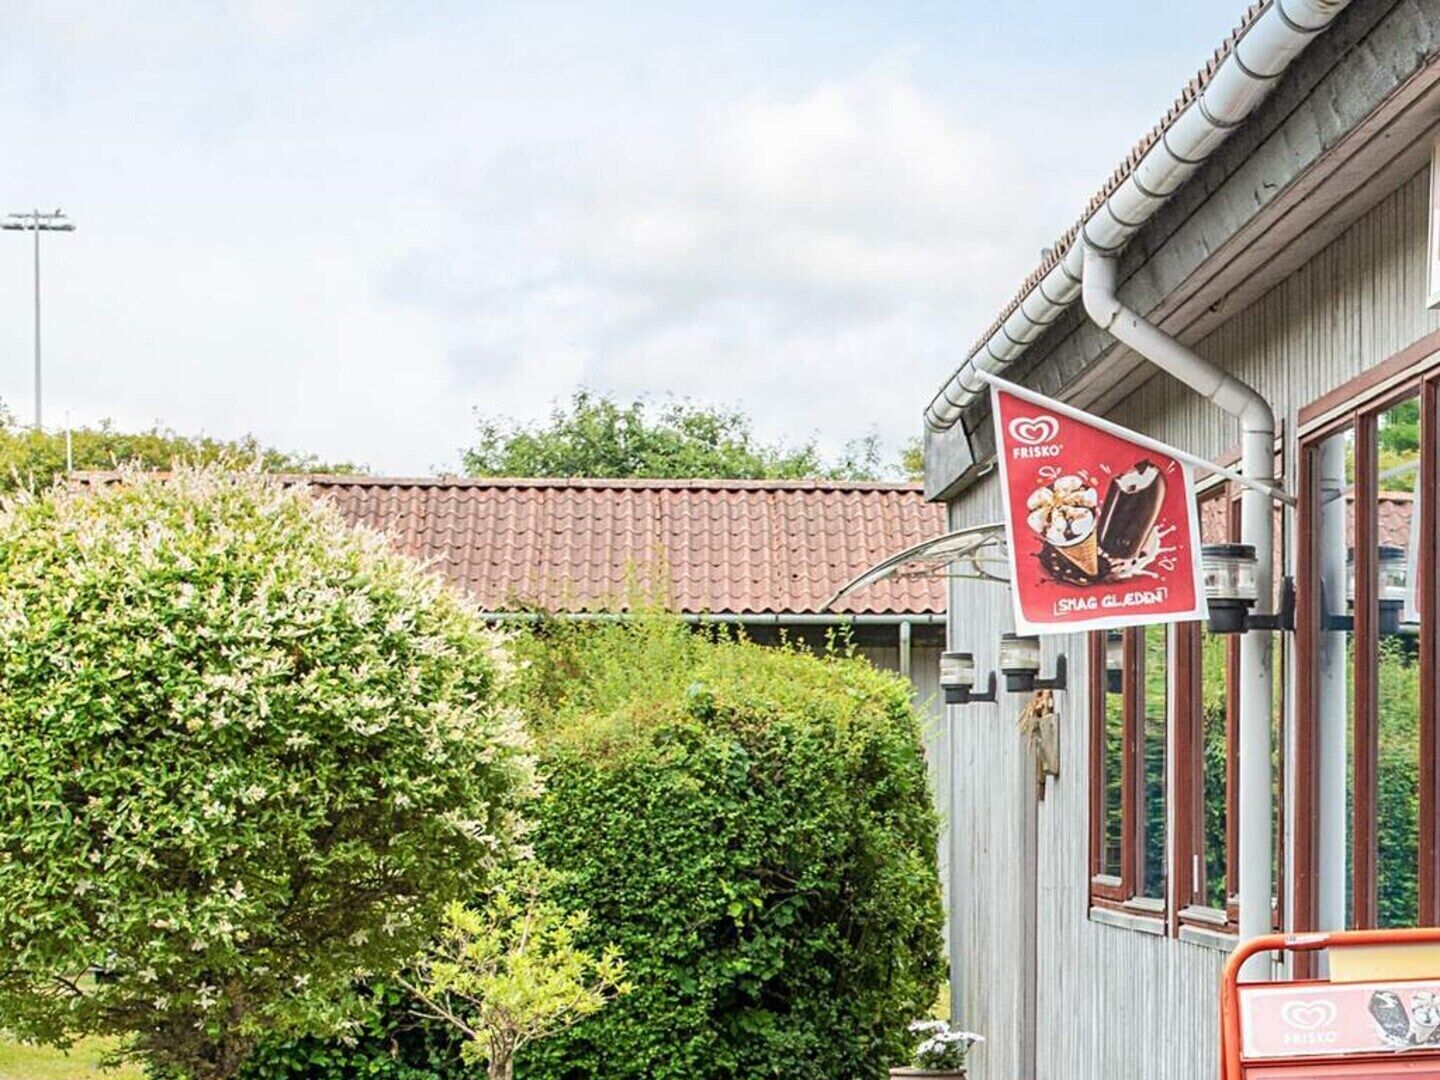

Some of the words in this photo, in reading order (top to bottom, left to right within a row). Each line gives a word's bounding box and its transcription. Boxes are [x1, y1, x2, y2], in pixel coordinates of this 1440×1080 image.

[1013, 445, 1060, 459] FRISKO
[1057, 594, 1097, 613] SMAG
[1101, 590, 1164, 609] GLÆDEN
[1283, 1030, 1336, 1045] FRISKO
